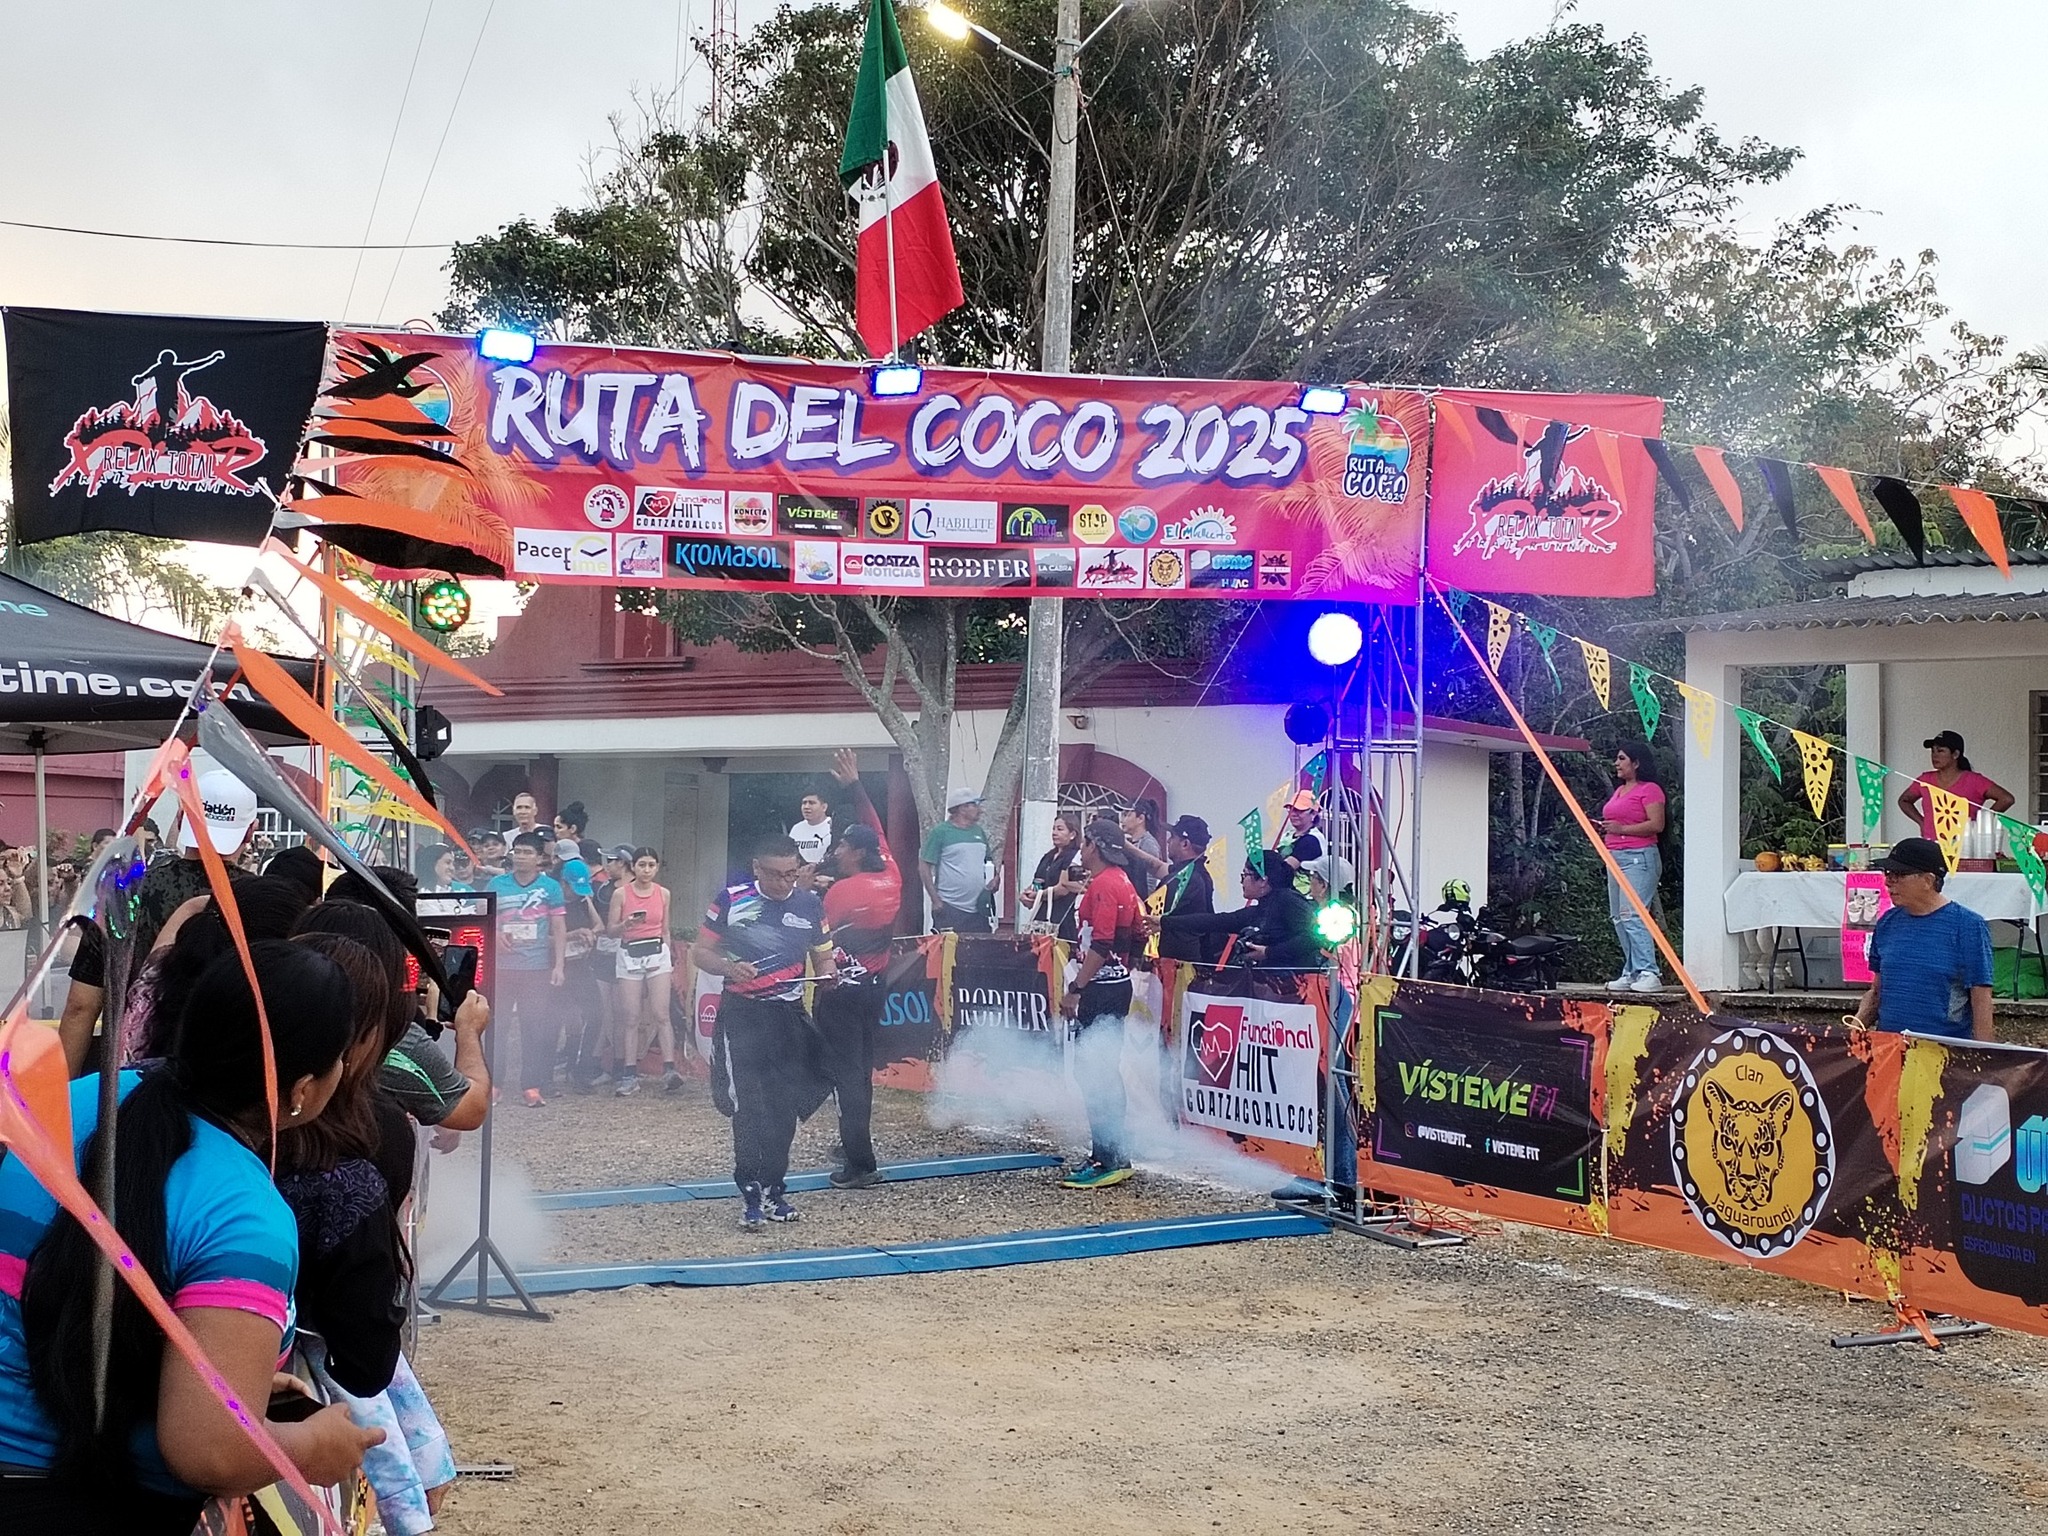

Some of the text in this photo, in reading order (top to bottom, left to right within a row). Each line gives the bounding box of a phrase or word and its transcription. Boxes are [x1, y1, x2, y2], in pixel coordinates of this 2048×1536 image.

[491, 369, 1309, 479] RUTA DEL COCO 2025
[103, 447, 218, 479] RELAX TOTAL
[1349, 457, 1384, 474] RUTA
[676, 494, 722, 505] Functional
[734, 508, 767, 516] KONECTA
[636, 518, 723, 529] COATZACOALCOS
[936, 516, 994, 530] HABILITE
[1498, 514, 1584, 540] RELAX TOTAL
[517, 541, 571, 560] Pacer
[864, 554, 920, 567] COATZA
[564, 559, 608, 573] time
[863, 567, 921, 578] NOTICIAS
[930, 557, 1030, 578] RODFER
[958, 987, 1050, 1032] RODFER
[1241, 1016, 1314, 1049] Functional
[1236, 1043, 1279, 1094] HIIT
[1735, 1064, 1764, 1085] Clan
[1185, 1088, 1314, 1135] COATZACOALCOS
[1711, 1193, 1796, 1229] Jaguaroundi
[1961, 1192, 2027, 1233] DUCTOS
[1963, 1235, 2022, 1262] ESPECIALISTA
